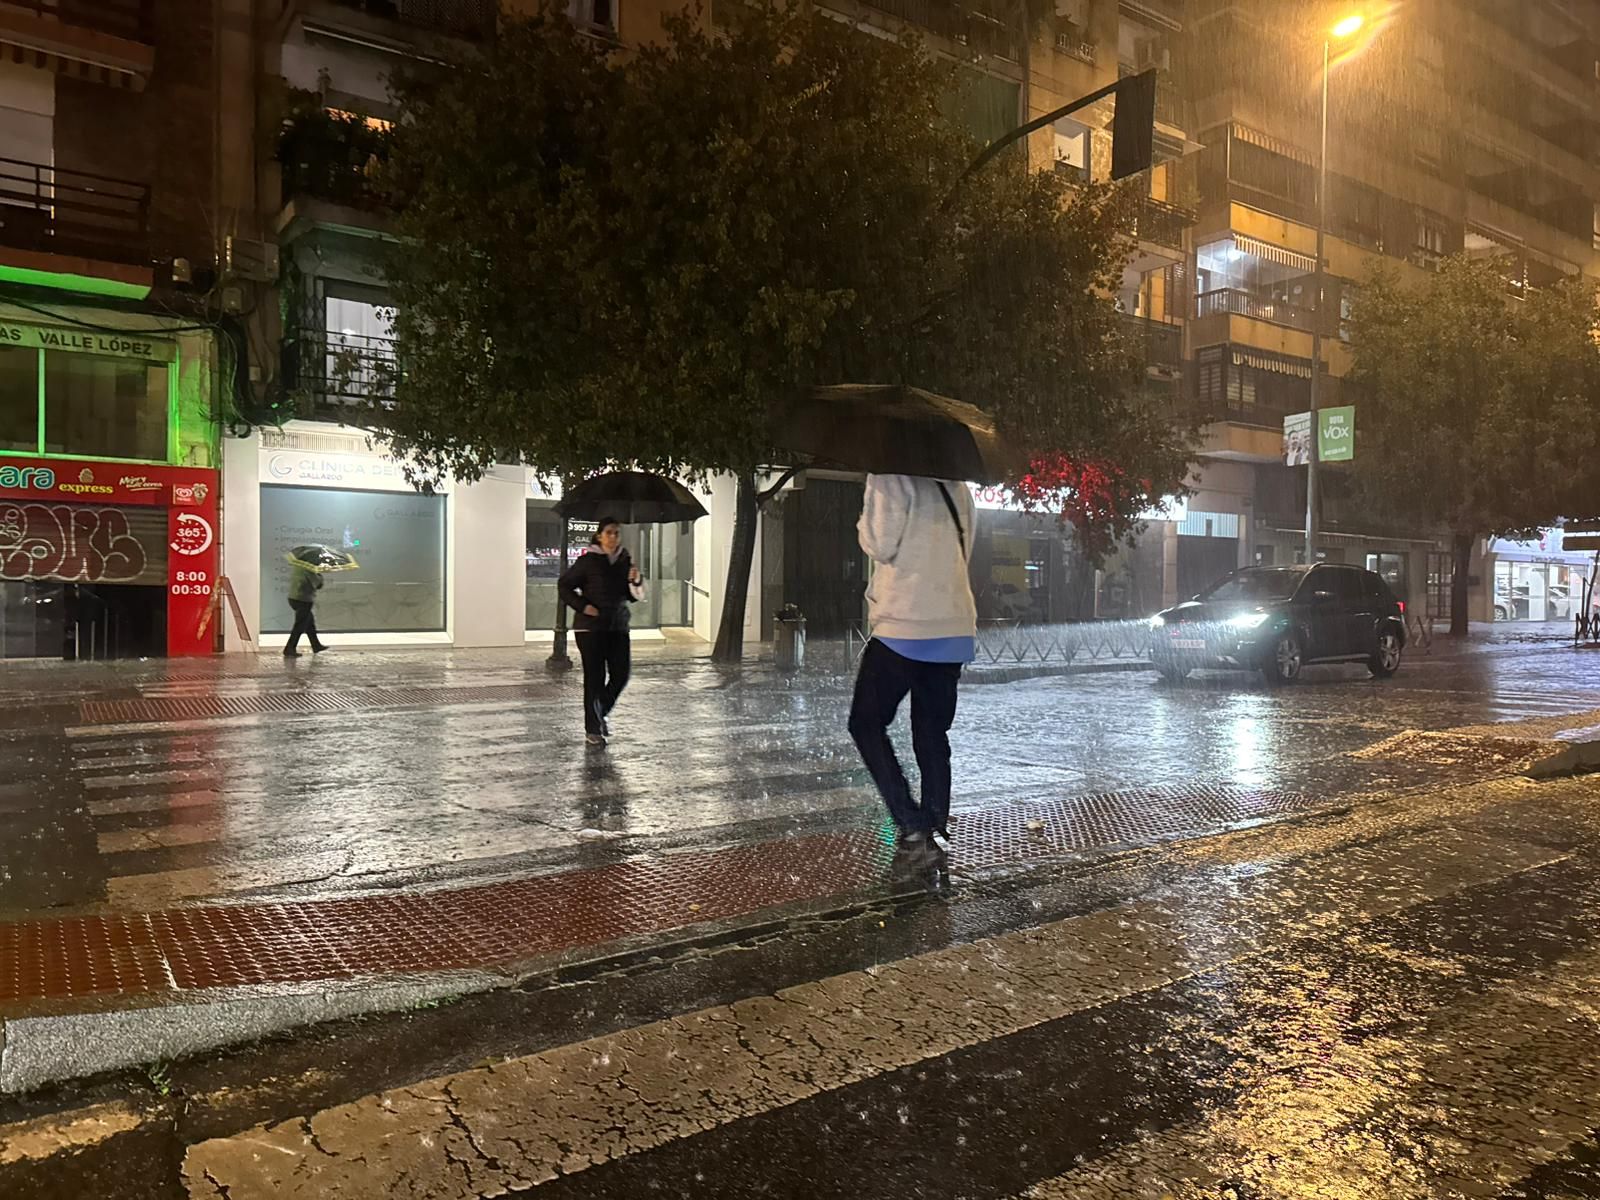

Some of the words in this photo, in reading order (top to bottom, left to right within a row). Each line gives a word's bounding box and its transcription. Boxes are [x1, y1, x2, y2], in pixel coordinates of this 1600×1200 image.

[38, 332, 93, 348] VALLE
[99, 337, 153, 355] LÓPEZ
[1323, 426, 1349, 440] VOX
[58, 482, 114, 494] express
[176, 528, 200, 538] 365
[176, 571, 206, 582] 8:00
[171, 584, 210, 595] 00:30
